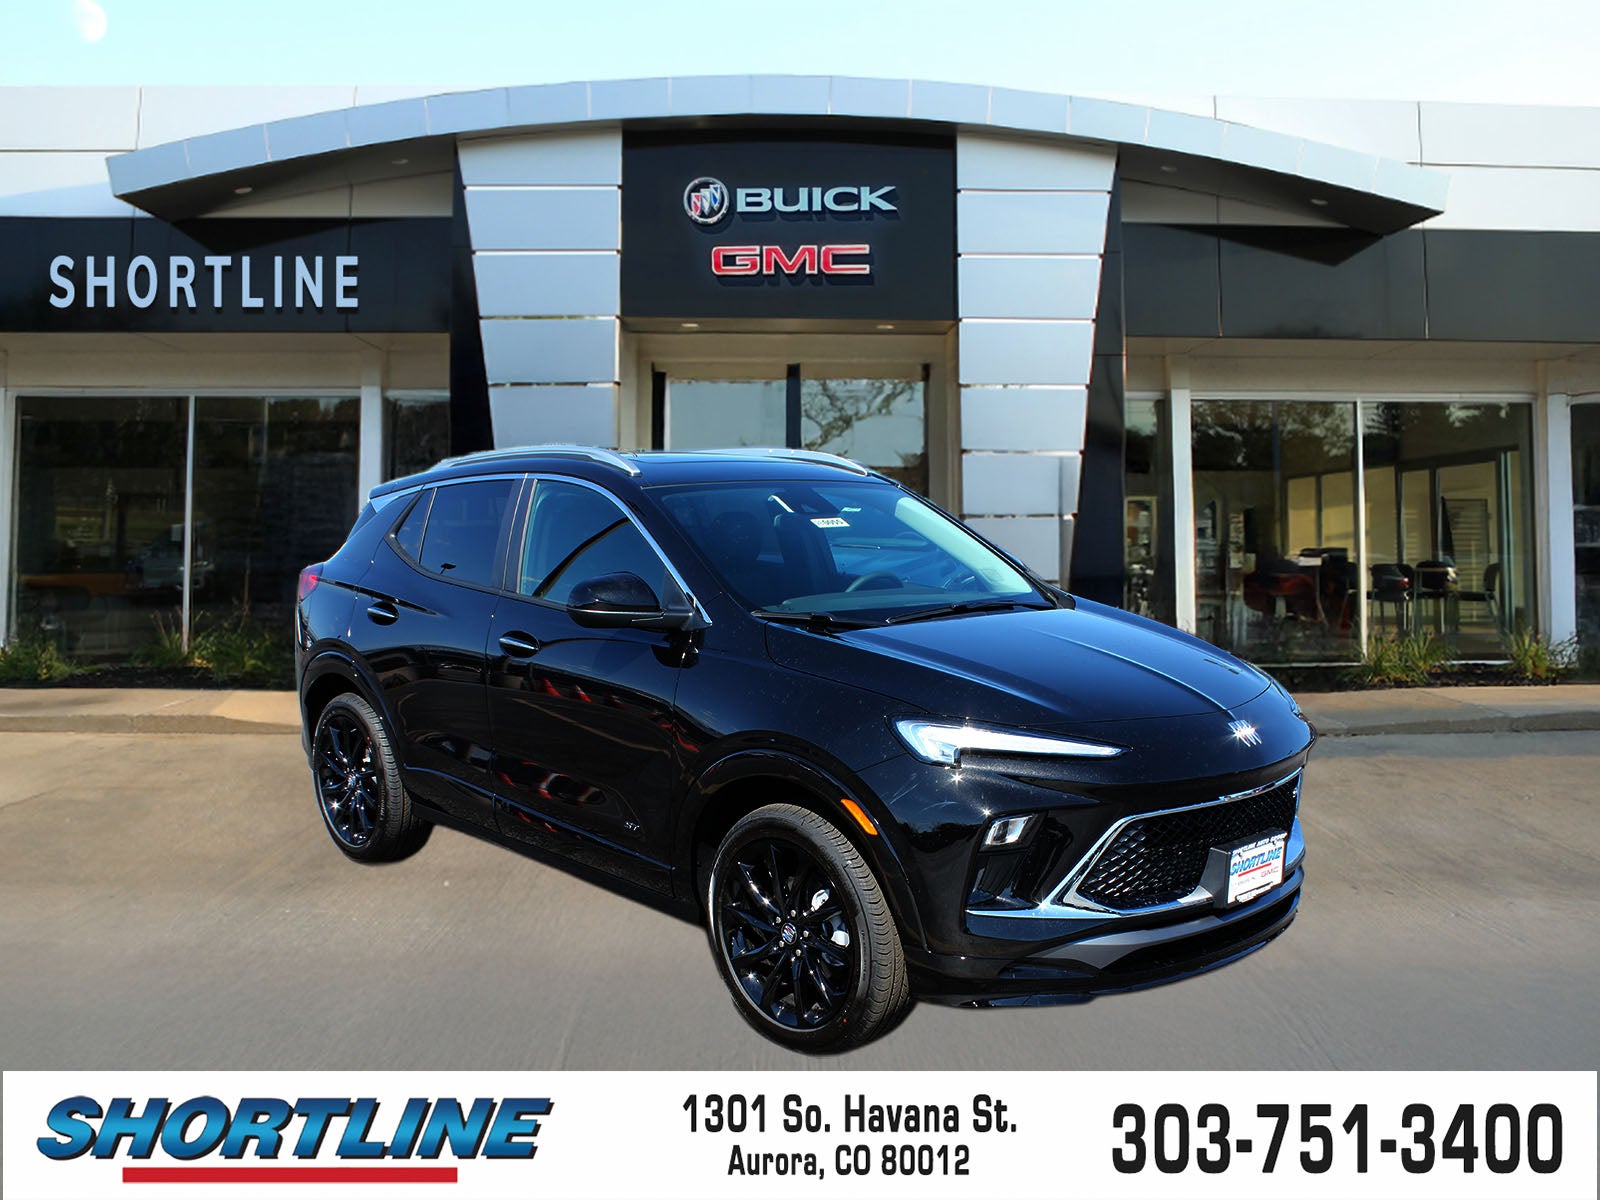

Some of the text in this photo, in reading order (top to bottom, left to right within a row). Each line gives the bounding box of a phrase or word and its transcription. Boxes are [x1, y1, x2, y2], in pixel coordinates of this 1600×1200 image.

[736, 186, 898, 213] BUICK
[711, 244, 870, 275] GMC
[49, 255, 360, 309] SHORTLINE
[1230, 846, 1283, 876] SHORTLINE
